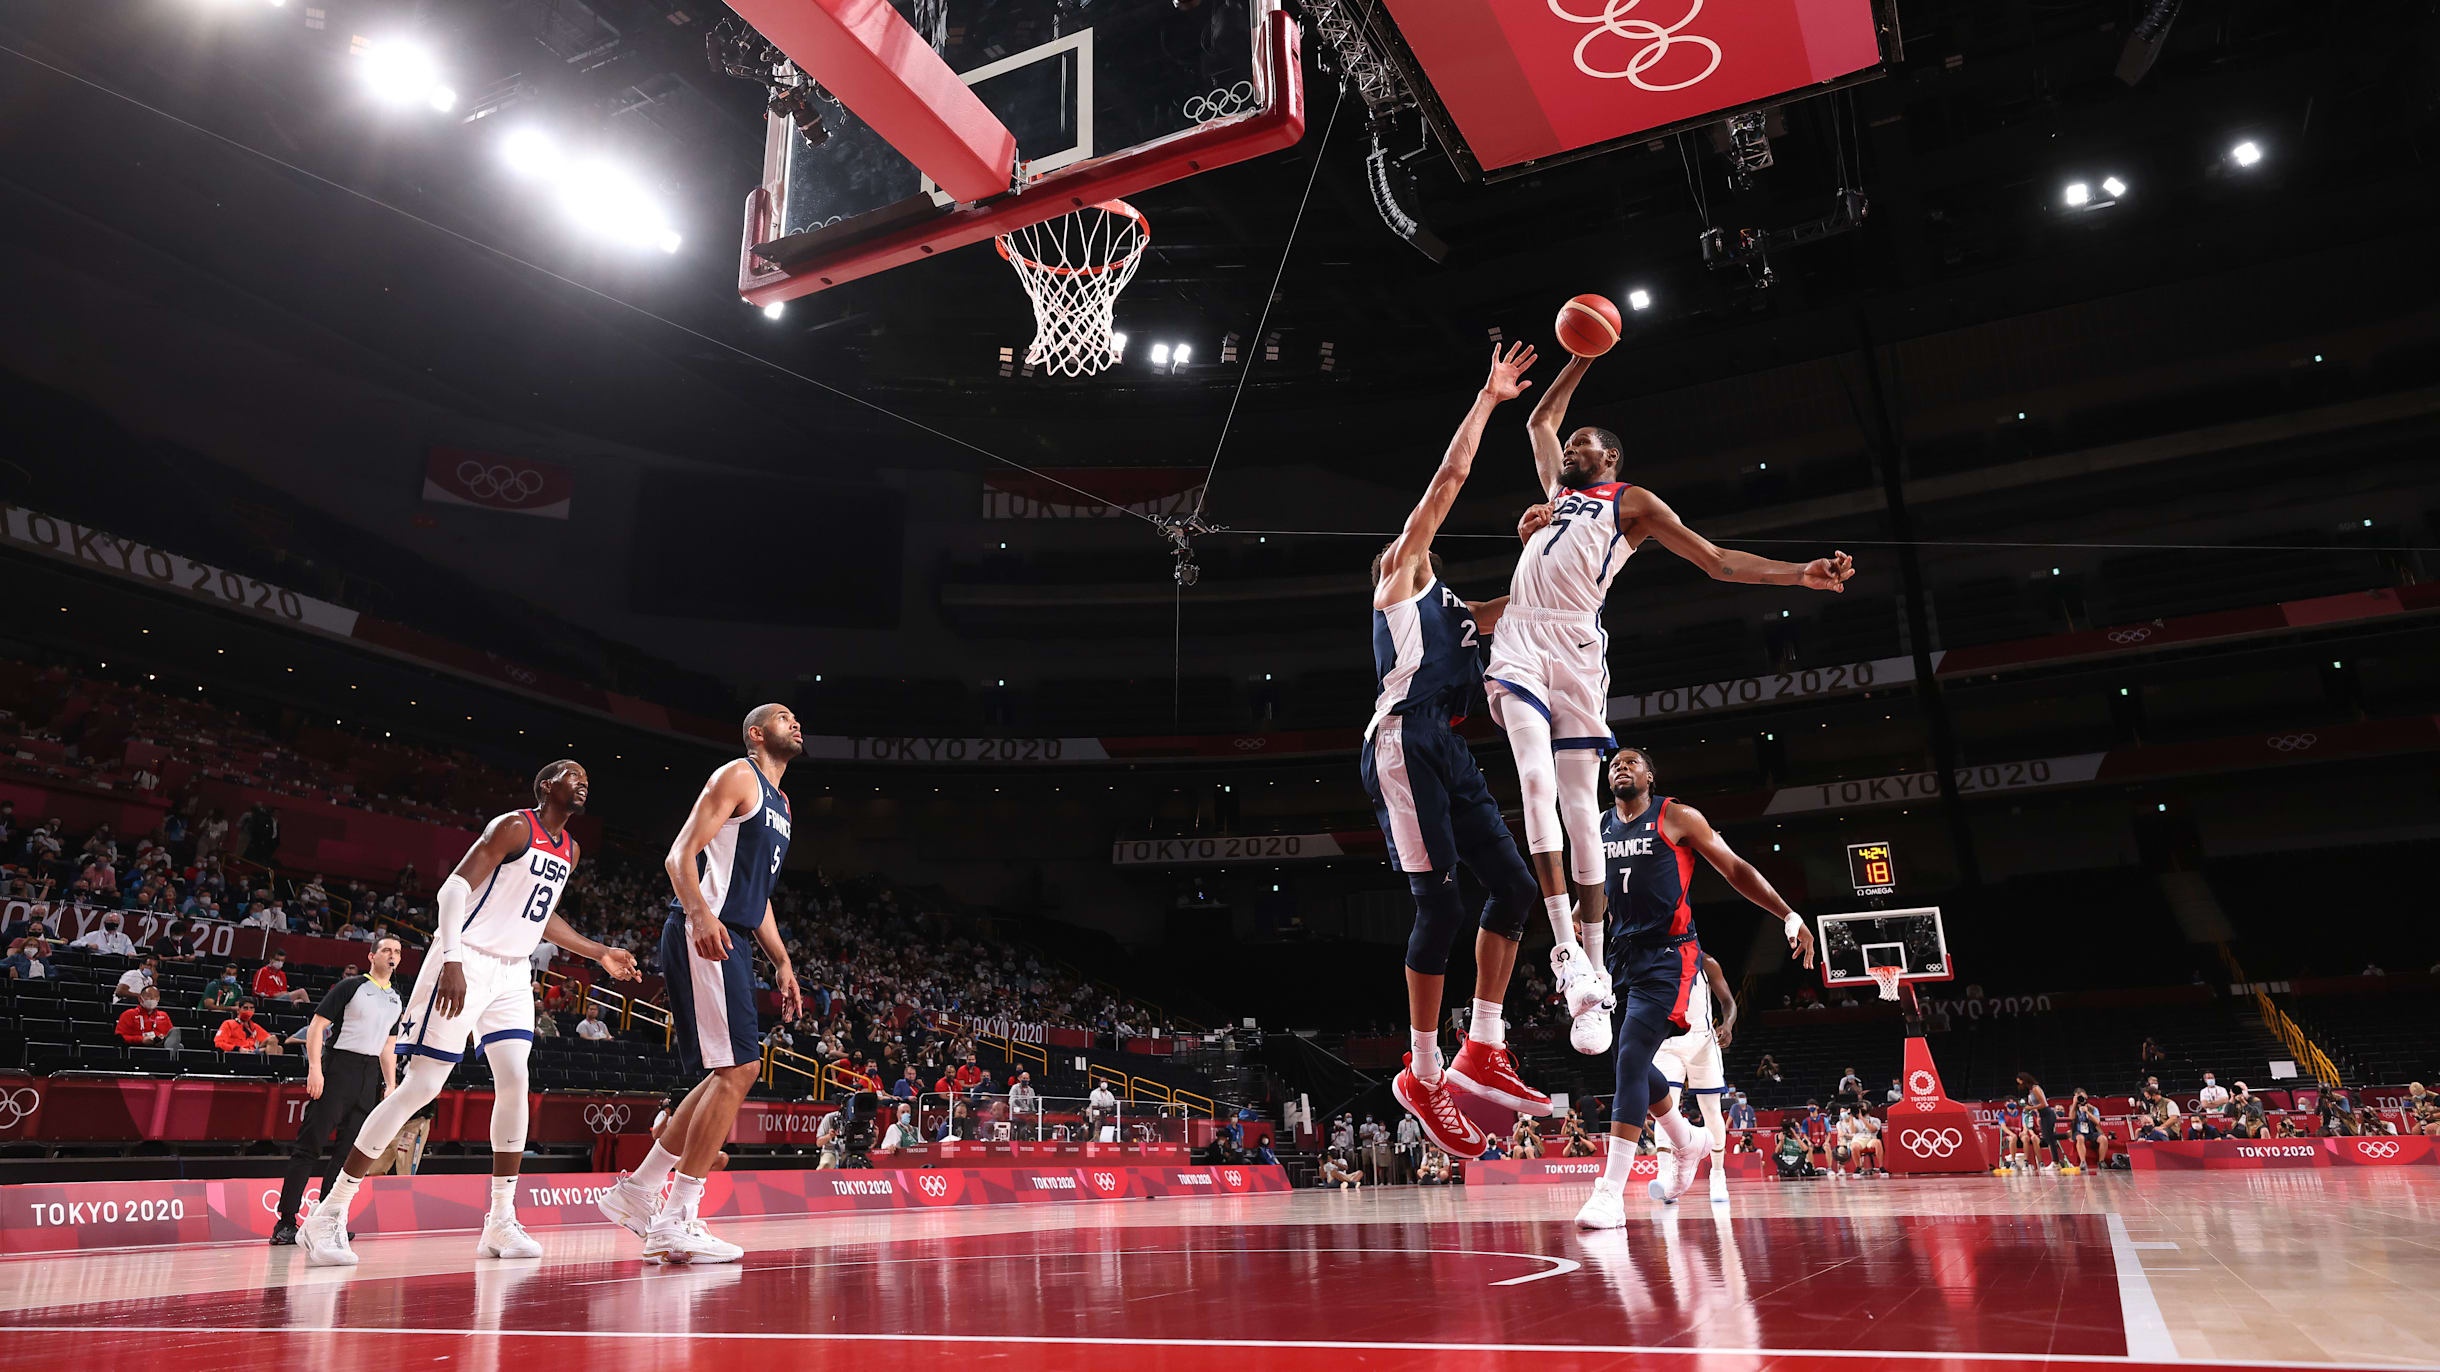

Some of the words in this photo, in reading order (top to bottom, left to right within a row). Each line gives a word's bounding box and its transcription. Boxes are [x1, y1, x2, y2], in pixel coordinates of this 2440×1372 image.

[1544, 519, 1571, 555] 7
[187, 560, 304, 621] 2020
[1633, 678, 1761, 719] TOKYO
[1774, 662, 1873, 699] 2020
[847, 737, 966, 760] TOKYO
[977, 738, 1062, 760] 2020
[1816, 774, 1939, 806] TOKYO
[1955, 761, 2051, 790] 2020
[771, 845, 780, 874] 5
[1114, 839, 1216, 861] TOKYO
[1225, 836, 1300, 858] 2020
[1601, 838, 1653, 859] FRANCE
[1859, 847, 1888, 860] 4:24
[530, 854, 567, 886] USA
[1619, 867, 1632, 893] 7
[1866, 861, 1889, 883] 18
[1865, 887, 1894, 895] OMEGA
[521, 883, 553, 922] 13
[1012, 1022, 1042, 1044] 2020
[757, 1114, 799, 1132] TOKYO
[2237, 1147, 2280, 1158] TOKYO
[2283, 1145, 2315, 1157] 2020
[1545, 1164, 1575, 1174] TOKYO
[1577, 1163, 1600, 1174] 2020
[832, 1180, 867, 1195] TOKYO
[867, 1180, 893, 1195] 2020
[1032, 1177, 1057, 1189] TOKYO
[1056, 1176, 1076, 1189] 2020
[529, 1187, 582, 1206] TOKYO
[31, 1201, 118, 1226] TOKYO
[125, 1198, 185, 1223] 2020
